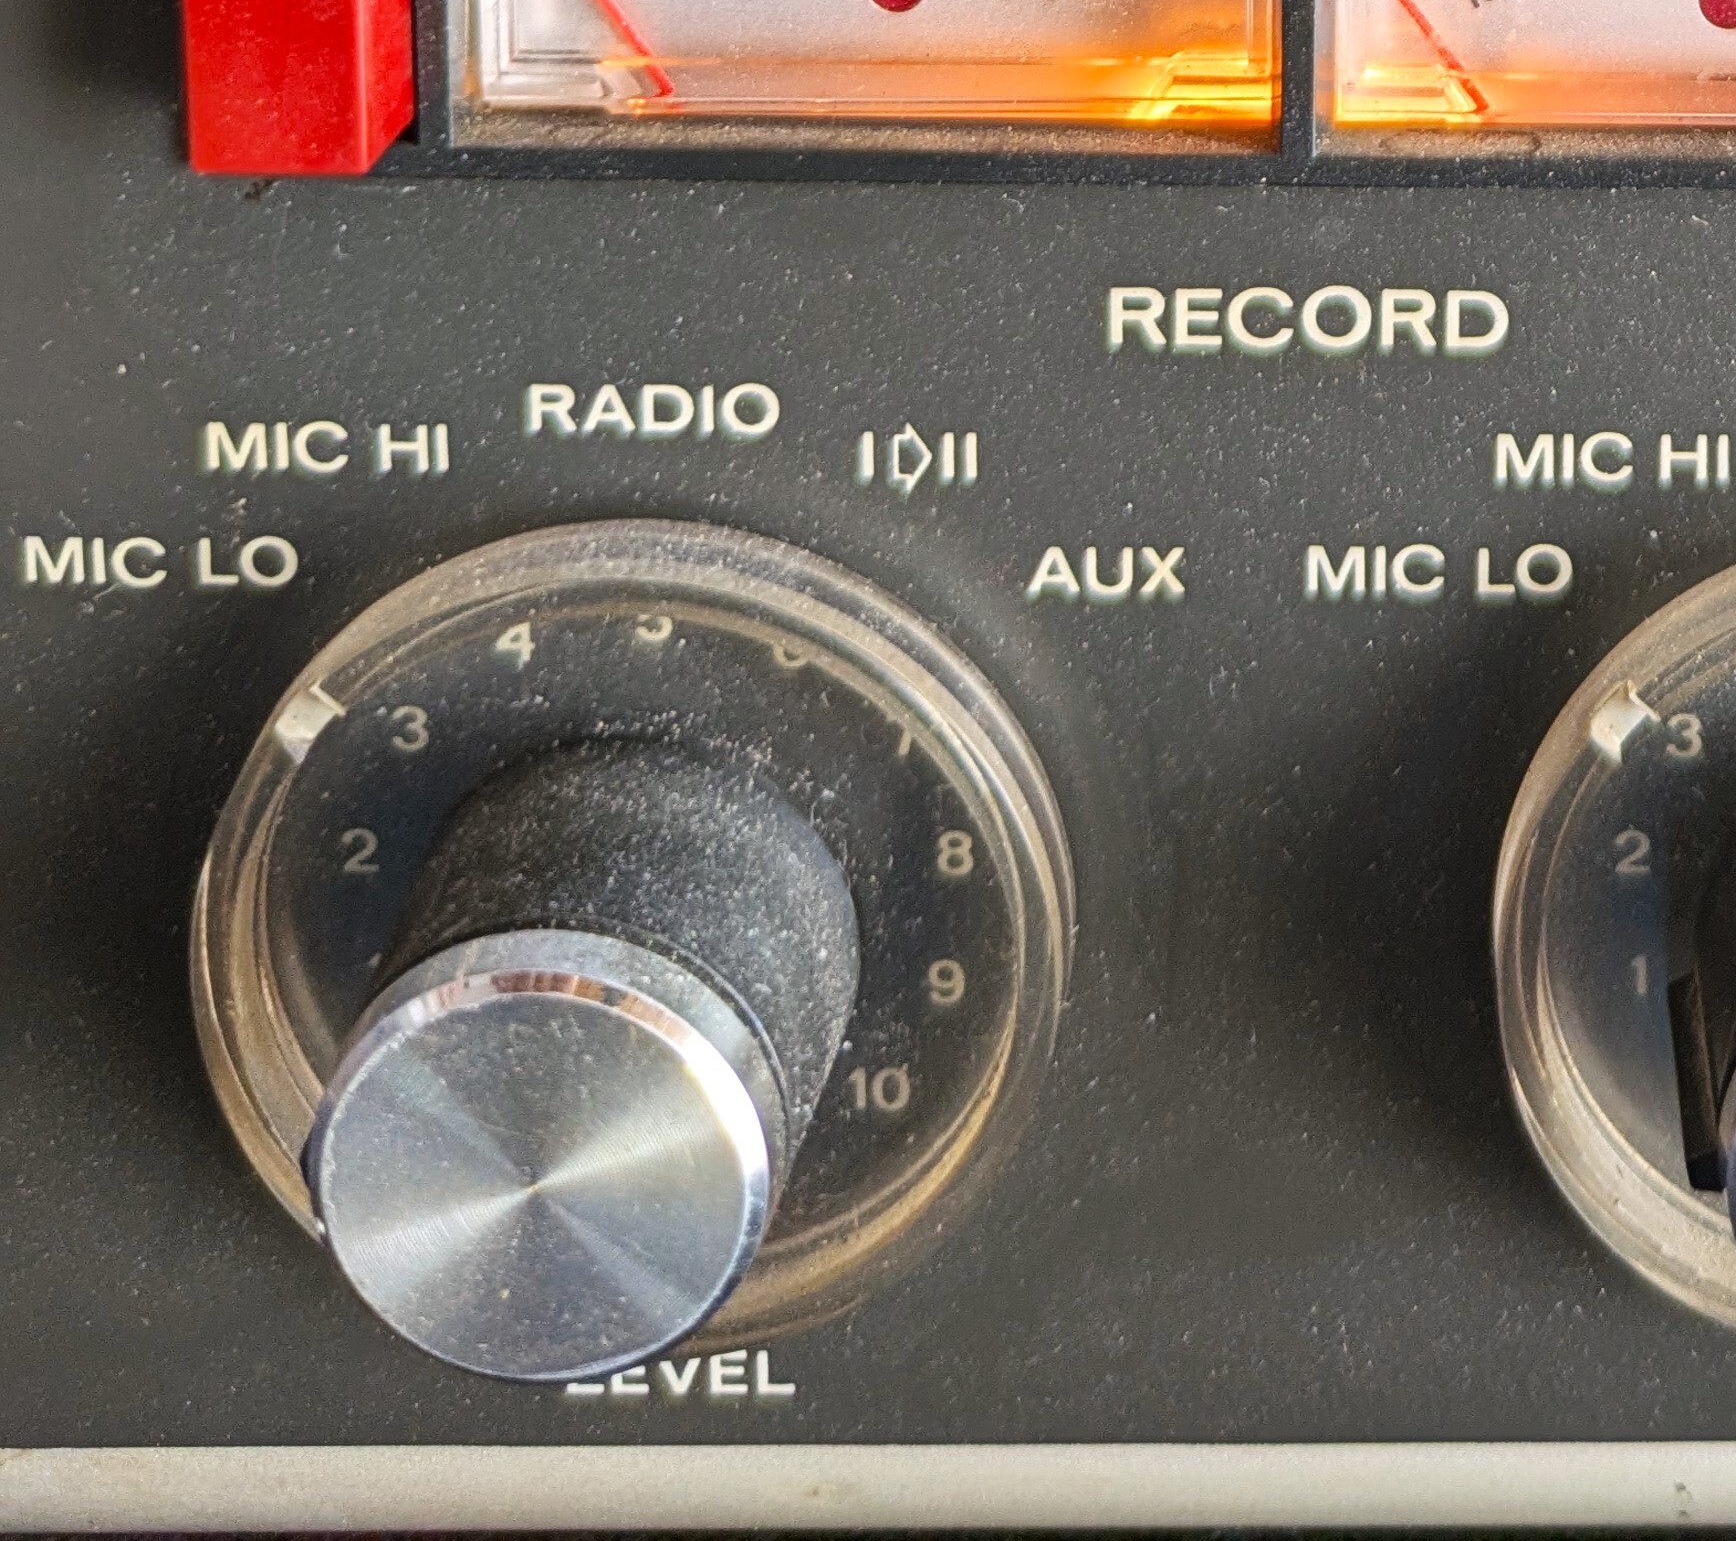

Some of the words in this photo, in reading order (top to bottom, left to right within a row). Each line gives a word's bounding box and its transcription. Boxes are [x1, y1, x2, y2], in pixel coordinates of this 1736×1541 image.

[1107, 284, 1510, 351] RECORD
[525, 382, 781, 435] RADIO
[206, 419, 349, 475] MIC
[375, 422, 450, 475] HI
[1496, 431, 1634, 486] MIC
[1657, 433, 1730, 487] HI
[23, 534, 167, 589] MIC
[197, 535, 300, 589] LO
[1028, 544, 1187, 598] AUX
[1305, 542, 1446, 597] MIC
[1476, 543, 1574, 597] LO
[496, 621, 536, 670] 4
[391, 705, 430, 752] 3
[1666, 713, 1703, 759] 3
[340, 828, 380, 875] 2
[937, 830, 974, 877] 8
[1615, 829, 1651, 875] 2
[927, 959, 965, 1005] 9
[1630, 954, 1648, 996] 1
[848, 1067, 911, 1113] 10
